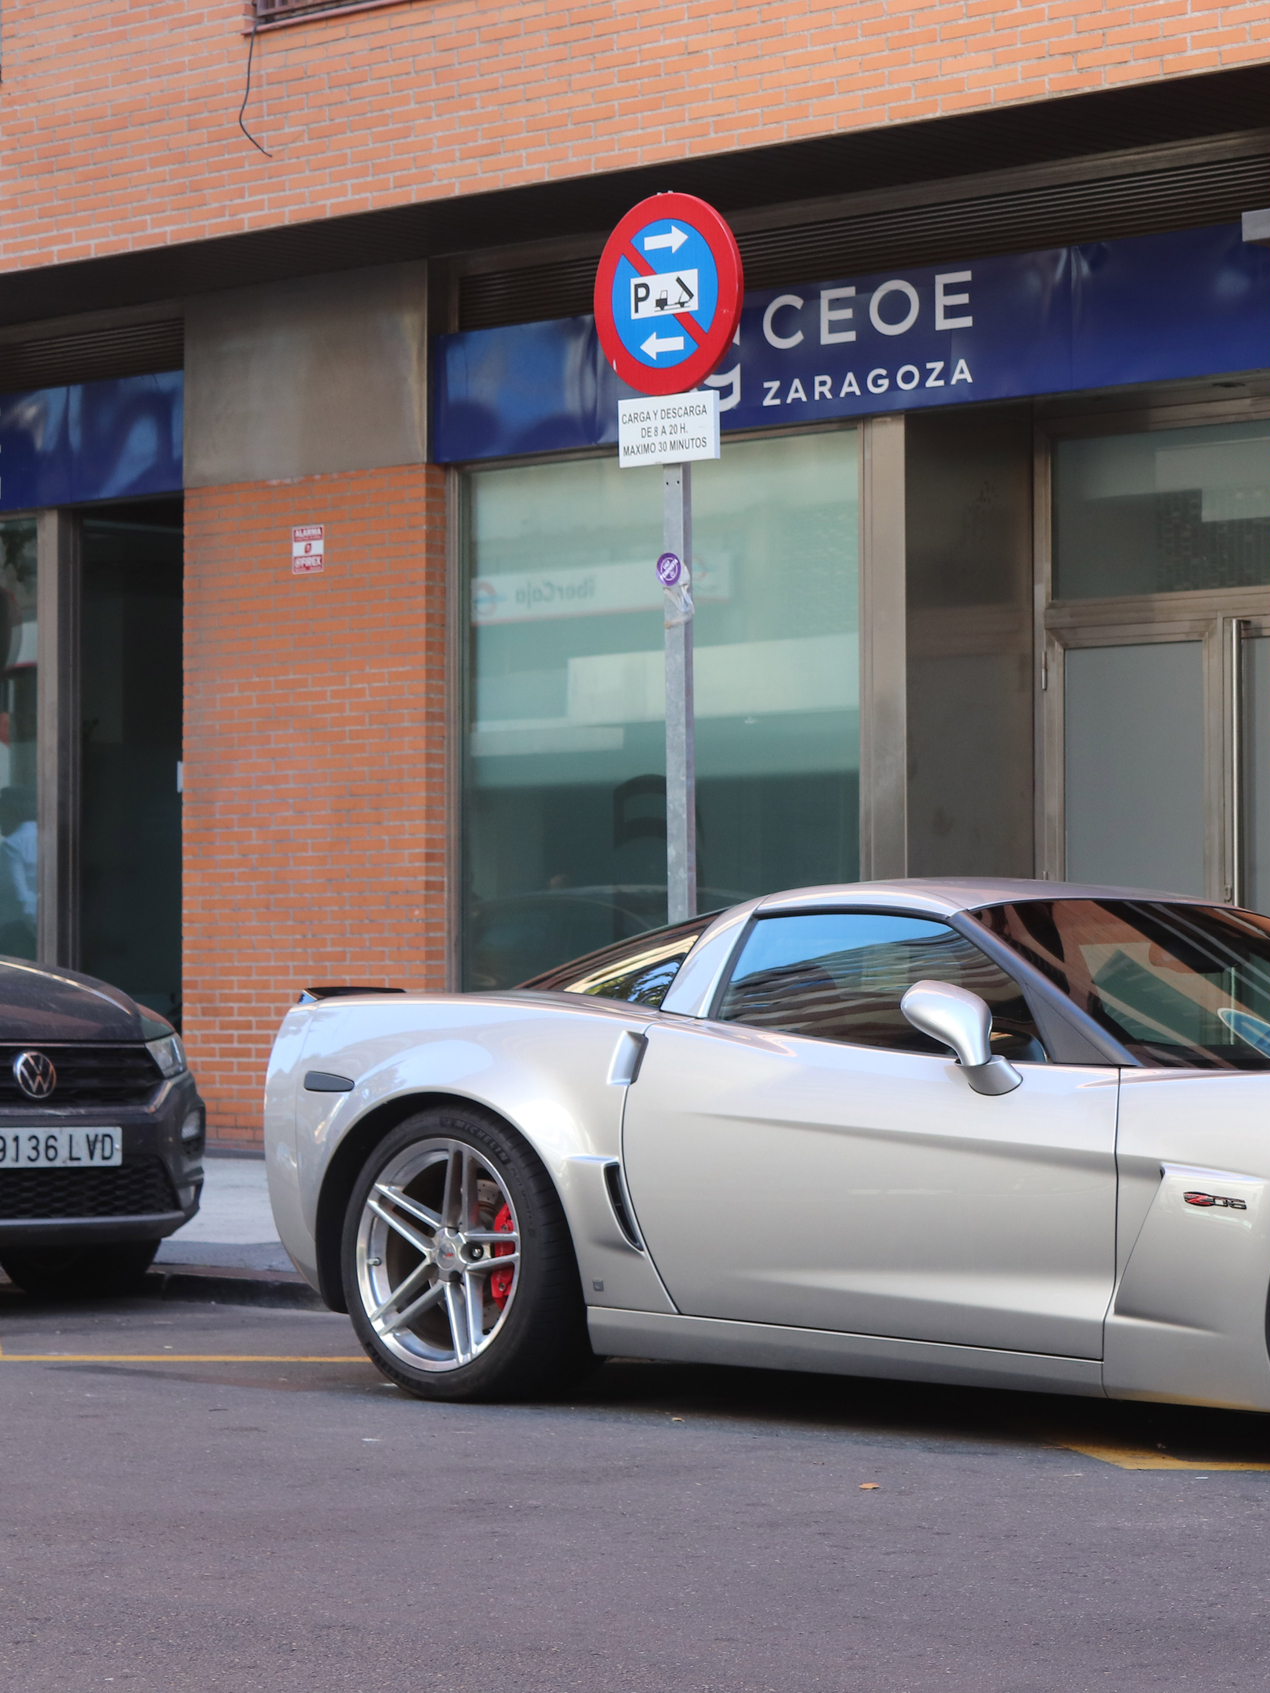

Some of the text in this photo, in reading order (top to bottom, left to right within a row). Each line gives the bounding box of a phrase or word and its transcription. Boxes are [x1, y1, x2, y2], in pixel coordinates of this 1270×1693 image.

[634, 282, 650, 314] P
[762, 270, 973, 350] CEOE
[762, 358, 973, 407] ZARAGOZA
[621, 404, 708, 425] CARGA Y DESCARGA
[641, 426, 652, 438] DE
[653, 426, 659, 437] 8
[661, 424, 667, 436] A
[669, 424, 678, 435] 20
[623, 436, 707, 457] MAXIMO 30 MINUTOS
[68, 1133, 114, 1161] LVD
